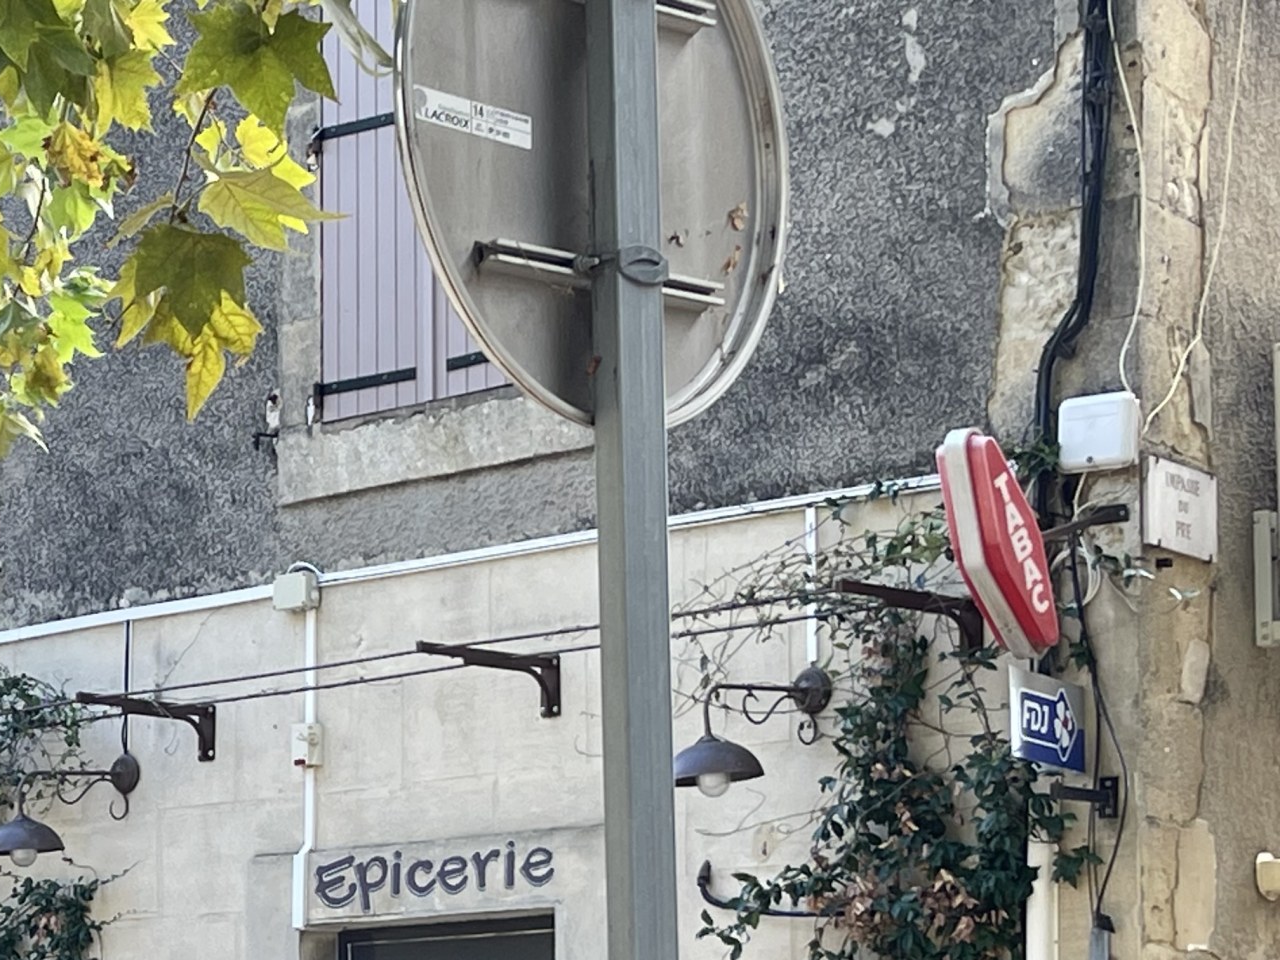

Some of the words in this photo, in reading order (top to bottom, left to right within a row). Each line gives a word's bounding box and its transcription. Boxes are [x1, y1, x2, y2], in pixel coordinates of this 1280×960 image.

[424, 107, 469, 130] LACROIX
[993, 471, 1050, 614] TABAC
[1022, 699, 1050, 735] FDJ
[315, 840, 555, 913] Epicerie
